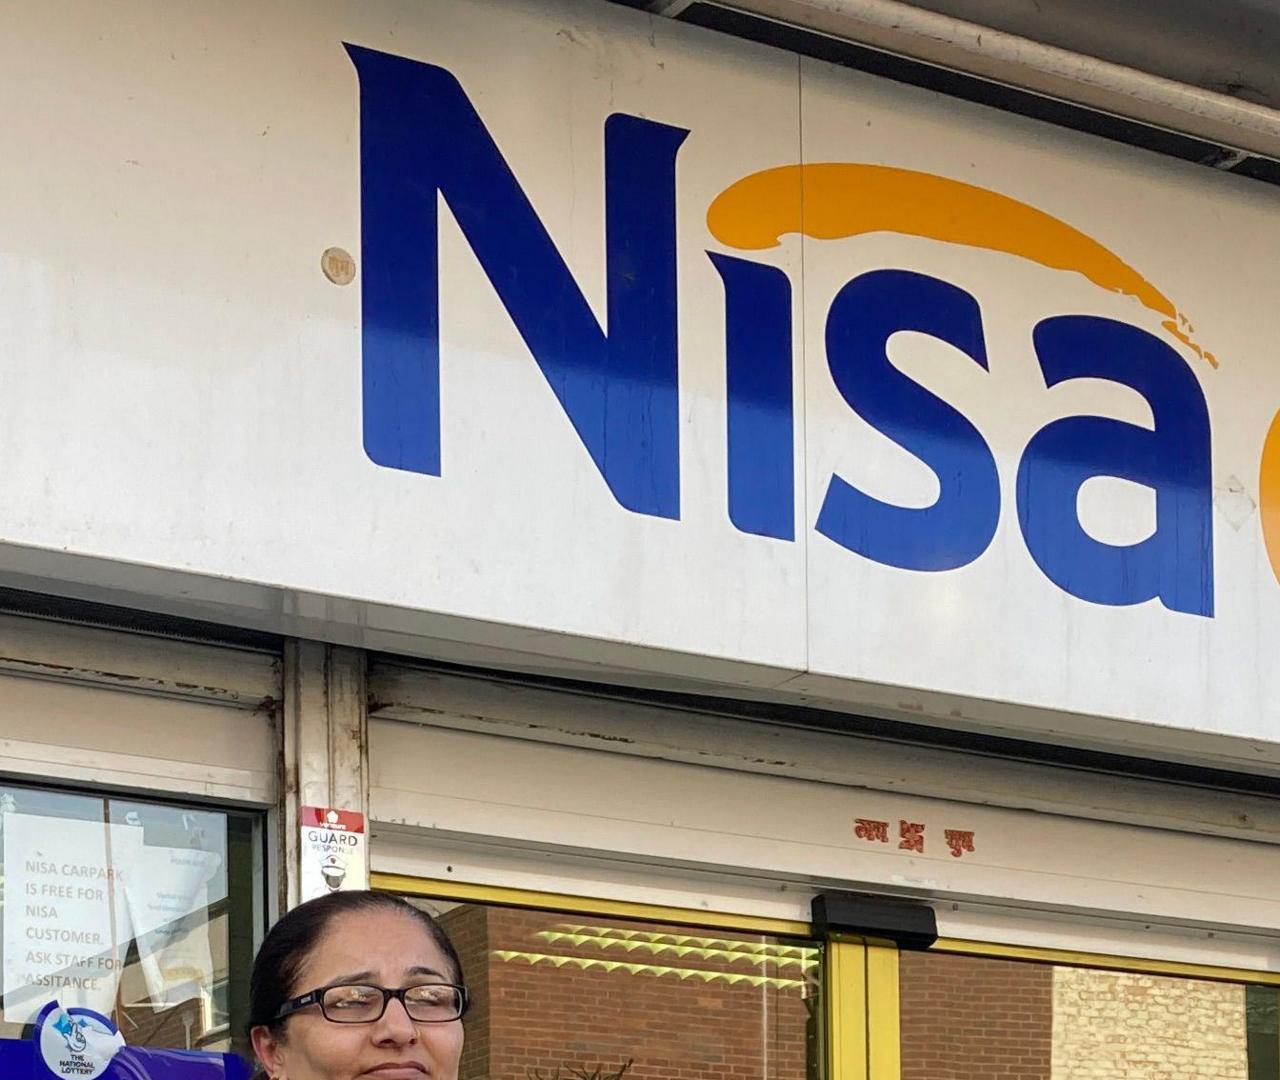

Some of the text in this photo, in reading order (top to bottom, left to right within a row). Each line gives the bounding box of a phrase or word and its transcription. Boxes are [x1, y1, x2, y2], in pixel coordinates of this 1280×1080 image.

[344, 41, 1217, 619] Nisa
[308, 831, 358, 847] GUARD
[26, 860, 125, 883] NISA CARPARK
[26, 882, 104, 902] IS FREE FOR
[26, 904, 59, 920] NISA
[26, 950, 122, 971] ASK STAFF FOR
[59, 1054, 96, 1076] THE NATIONAL LOTTERY
